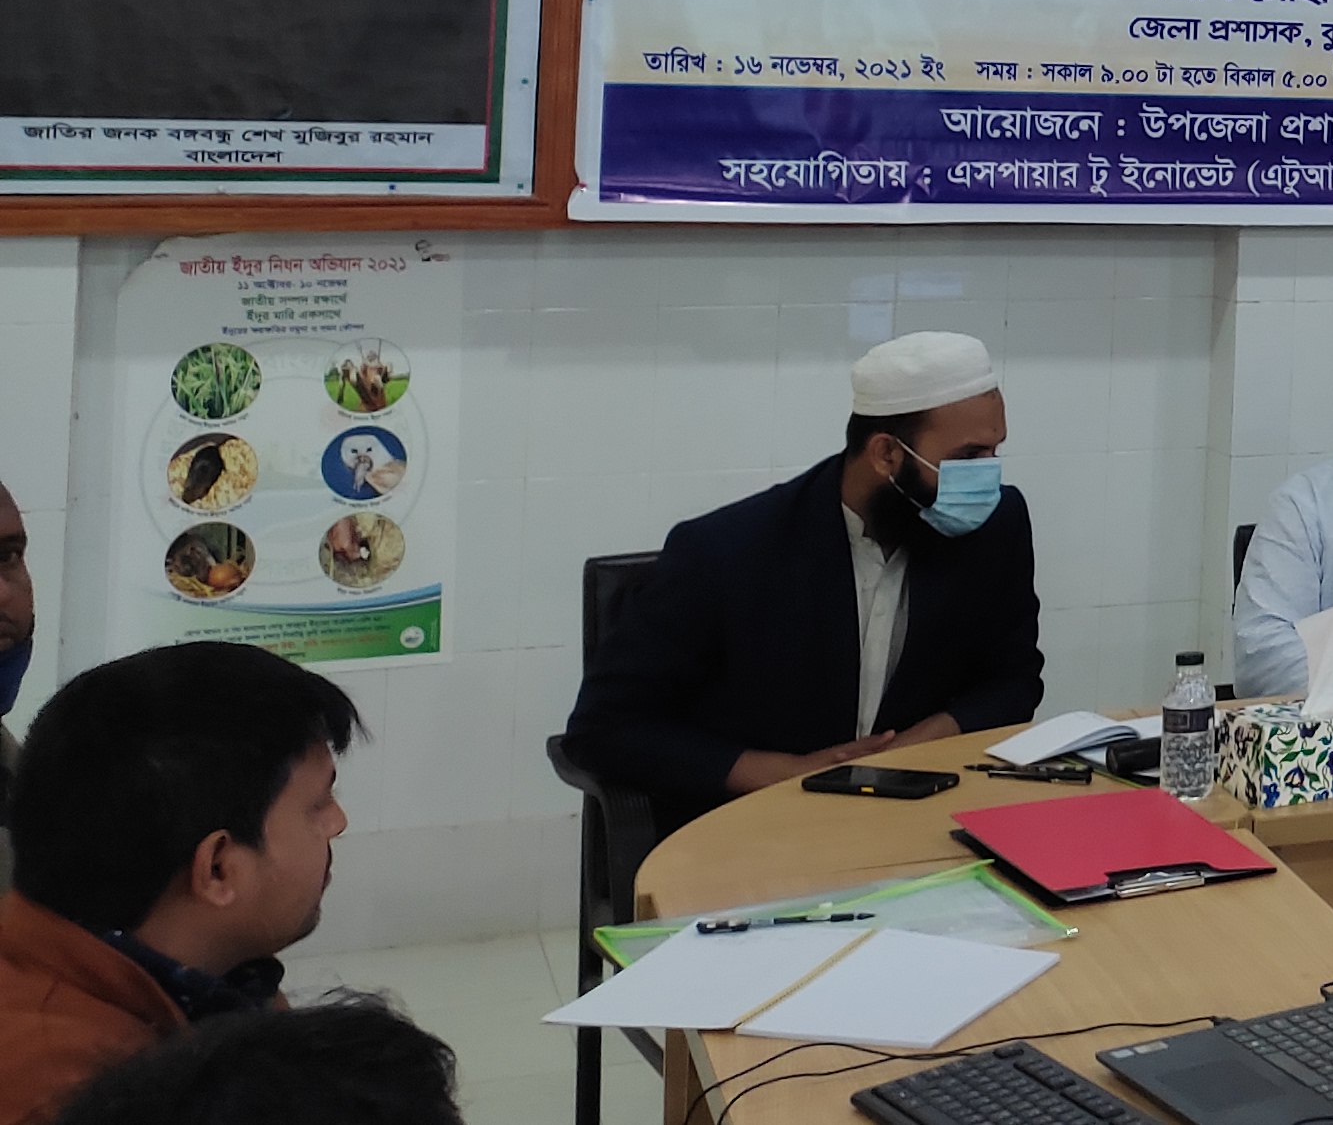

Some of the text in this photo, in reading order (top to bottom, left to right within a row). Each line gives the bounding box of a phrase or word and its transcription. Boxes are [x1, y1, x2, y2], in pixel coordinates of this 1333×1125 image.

[1129, 17, 1201, 40] জেলা
[1208, 19, 1312, 48] প্রশাসক,
[643, 46, 707, 74] তারিখ
[733, 56, 762, 76] ১৬
[770, 55, 845, 81] নভেম্বর,
[855, 58, 912, 80] ২০২১
[920, 53, 946, 81] ইং
[975, 61, 1018, 83] সময়
[1041, 63, 1093, 84] সকাল
[1155, 61, 1173, 86] টা
[1180, 66, 1218, 87] হতে
[1224, 61, 1275, 88] বিকাল
[22, 122, 434, 147] জাতির জনক বঙ্গবন্ধু শেখ মুজিবুর রহমান
[940, 105, 1103, 141] আয়োজনে
[1138, 102, 1271, 143] উপজেলা
[184, 149, 284, 164] বাংলাদেশ
[718, 150, 910, 192] সহযোগিতায়
[947, 158, 1081, 189] এসপায়ার
[1088, 153, 1112, 197] টু
[1118, 154, 1237, 192] ইনোভেট
[180, 255, 225, 276] জাতীয়
[269, 254, 303, 274] নিধন
[309, 254, 363, 273] অভিযান
[367, 256, 407, 272] ২০২১
